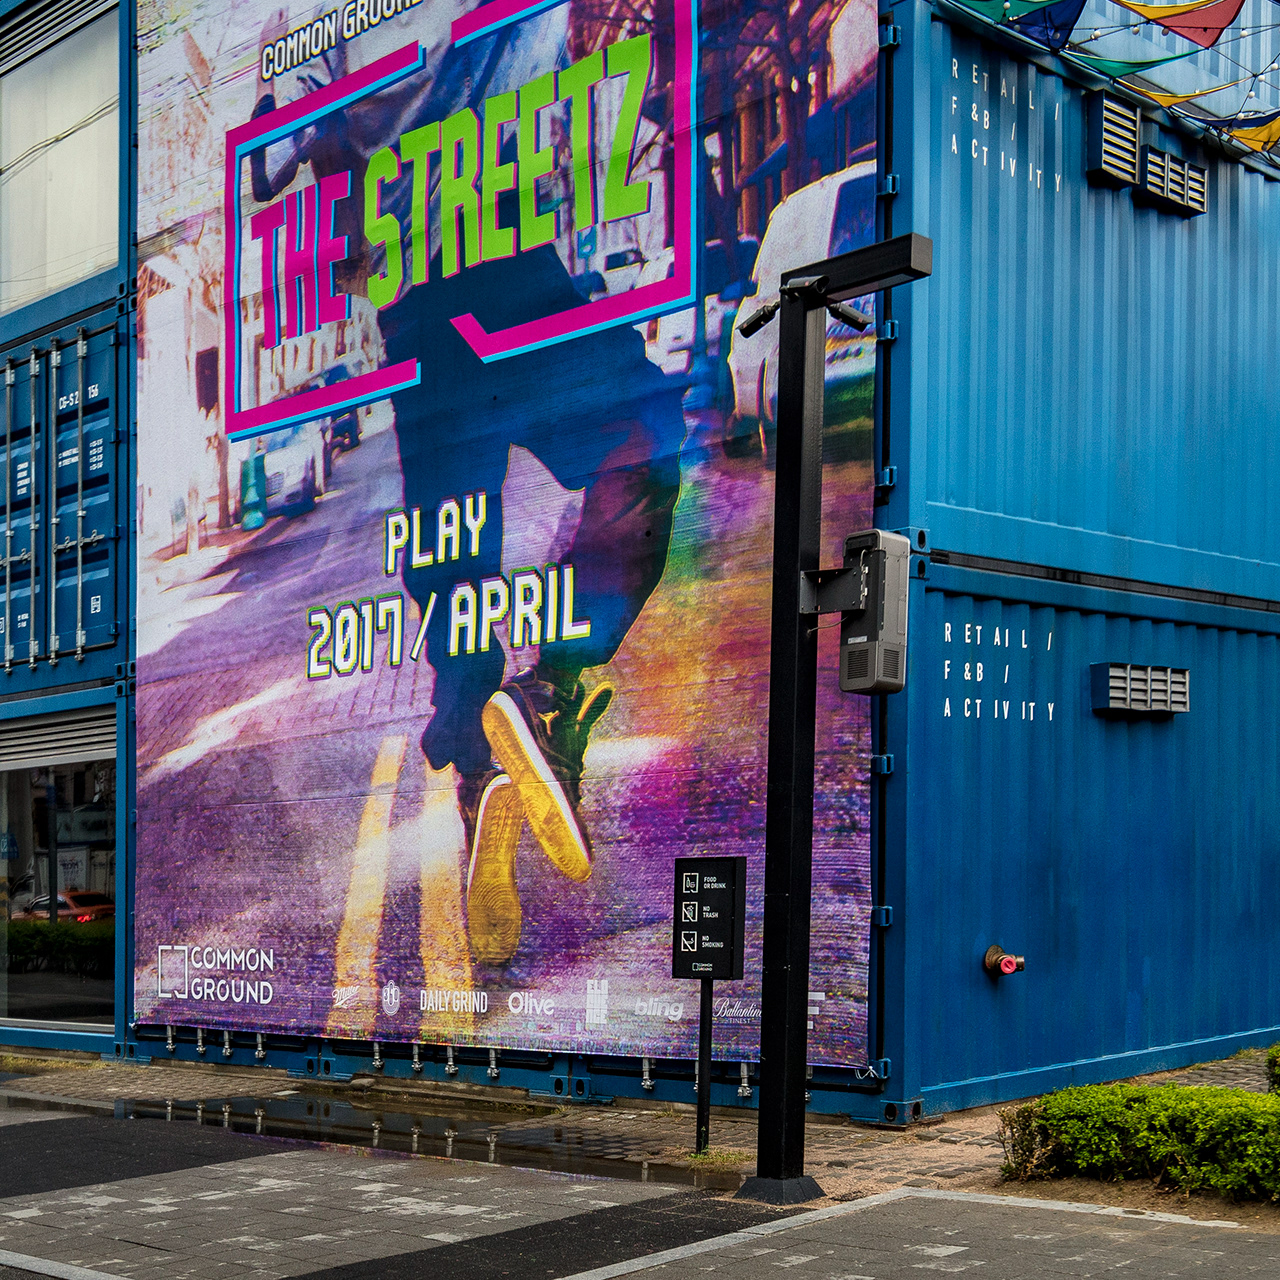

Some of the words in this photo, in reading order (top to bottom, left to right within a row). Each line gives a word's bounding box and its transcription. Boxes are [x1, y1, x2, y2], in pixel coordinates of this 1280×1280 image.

[261, 19, 337, 82] COMMON
[952, 57, 1035, 110] RETAIL
[951, 95, 990, 131] F&B
[951, 133, 1061, 193] ACTIVITY
[250, 169, 354, 351] THE
[363, 32, 659, 313] STREETZ
[383, 488, 487, 578] PLAY
[446, 562, 592, 657] APRIL
[944, 622, 1028, 649] RETAIL
[944, 659, 984, 682] F&B
[944, 697, 1055, 722] ACTIVITY
[190, 946, 274, 972] COMMON
[190, 977, 274, 1005] GROUND
[419, 989, 451, 1012] DAILY
[451, 990, 488, 1014] GRIND
[634, 996, 684, 1021] bling
